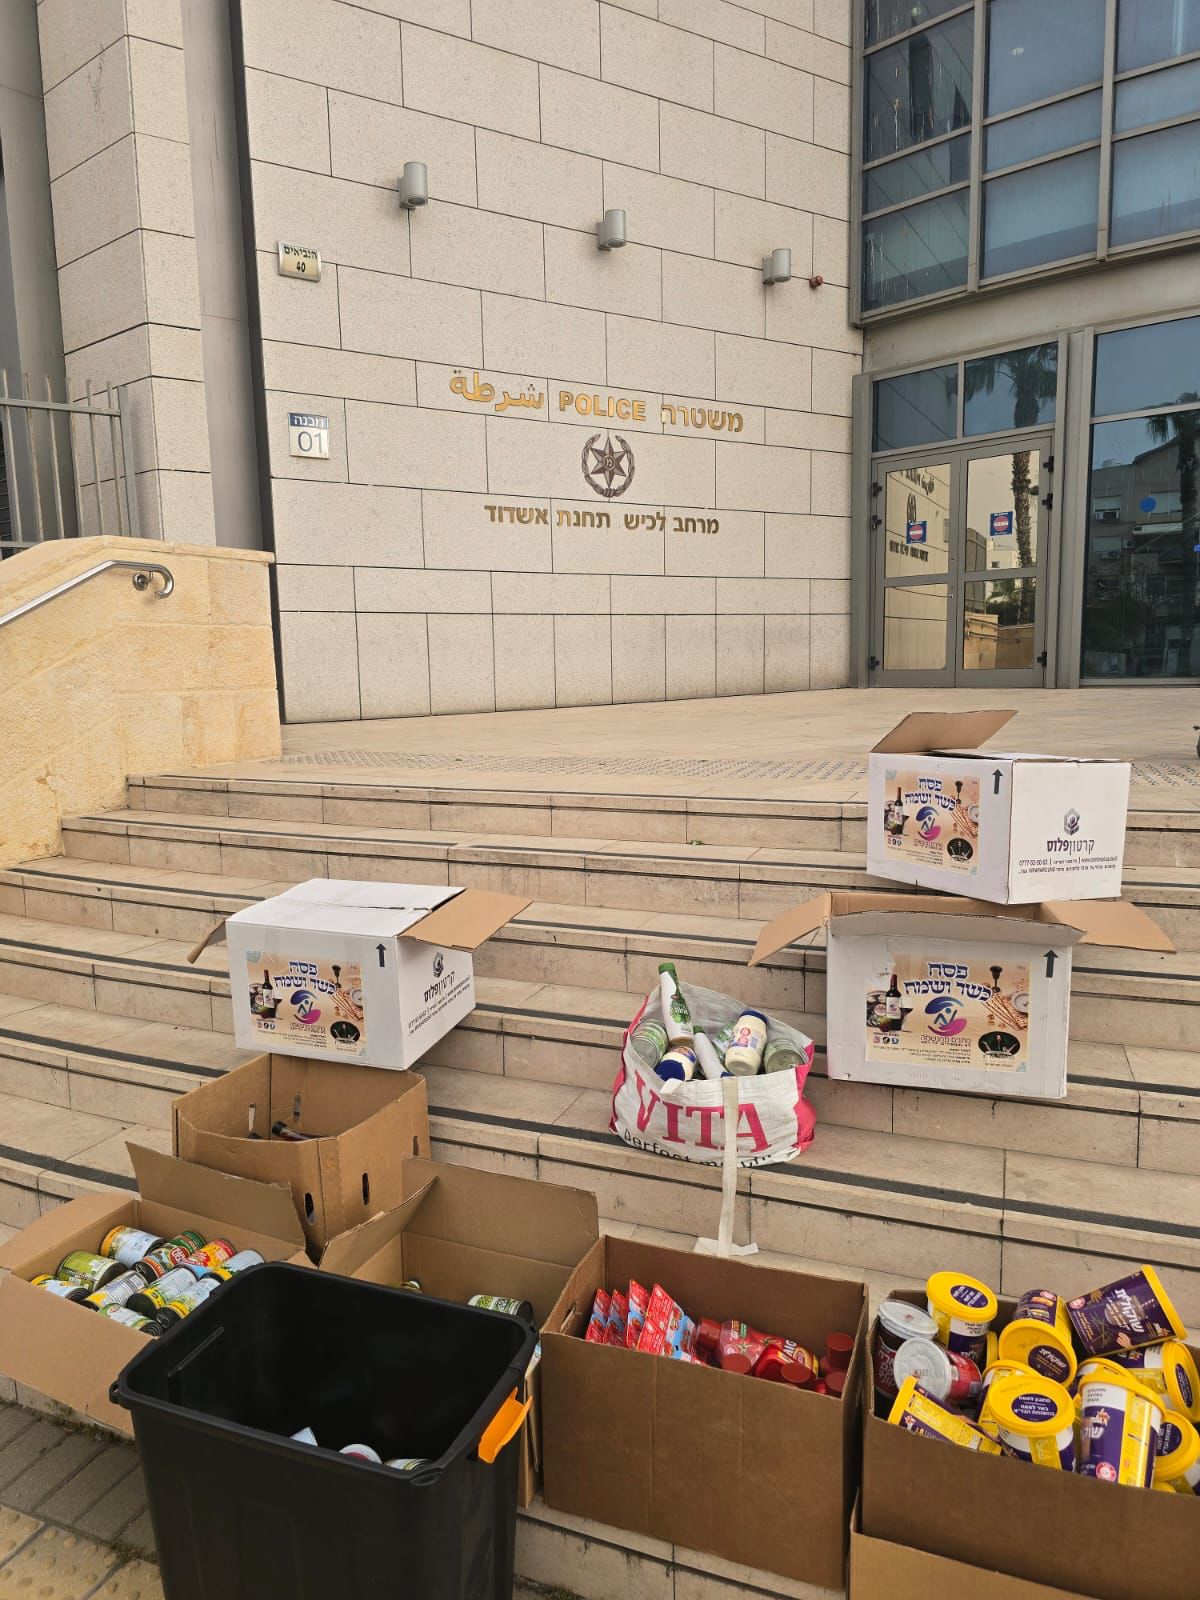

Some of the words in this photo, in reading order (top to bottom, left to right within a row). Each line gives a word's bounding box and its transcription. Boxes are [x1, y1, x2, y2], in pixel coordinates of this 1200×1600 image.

[284, 246, 318, 260] הנביאים
[296, 261, 306, 273] 40
[449, 369, 545, 412] شرطة
[559, 390, 647, 422] POLICE
[294, 415, 324, 429] מבנה
[660, 403, 745, 433] משטרה
[297, 431, 323, 454] 01
[484, 504, 550, 525] אשדוד
[556, 508, 612, 529] תחנת
[623, 511, 667, 533] לכיש
[672, 515, 720, 535] מרחב
[918, 777, 943, 792] פסח
[904, 792, 932, 805] ושמח
[934, 793, 957, 811] כשר
[288, 960, 318, 976] פסח
[927, 962, 969, 980] פסח
[272, 975, 308, 989] ושמח
[309, 977, 338, 996] כשר
[903, 979, 952, 996] ושמח
[955, 981, 993, 1002] כשר
[634, 1070, 773, 1153] VITA
